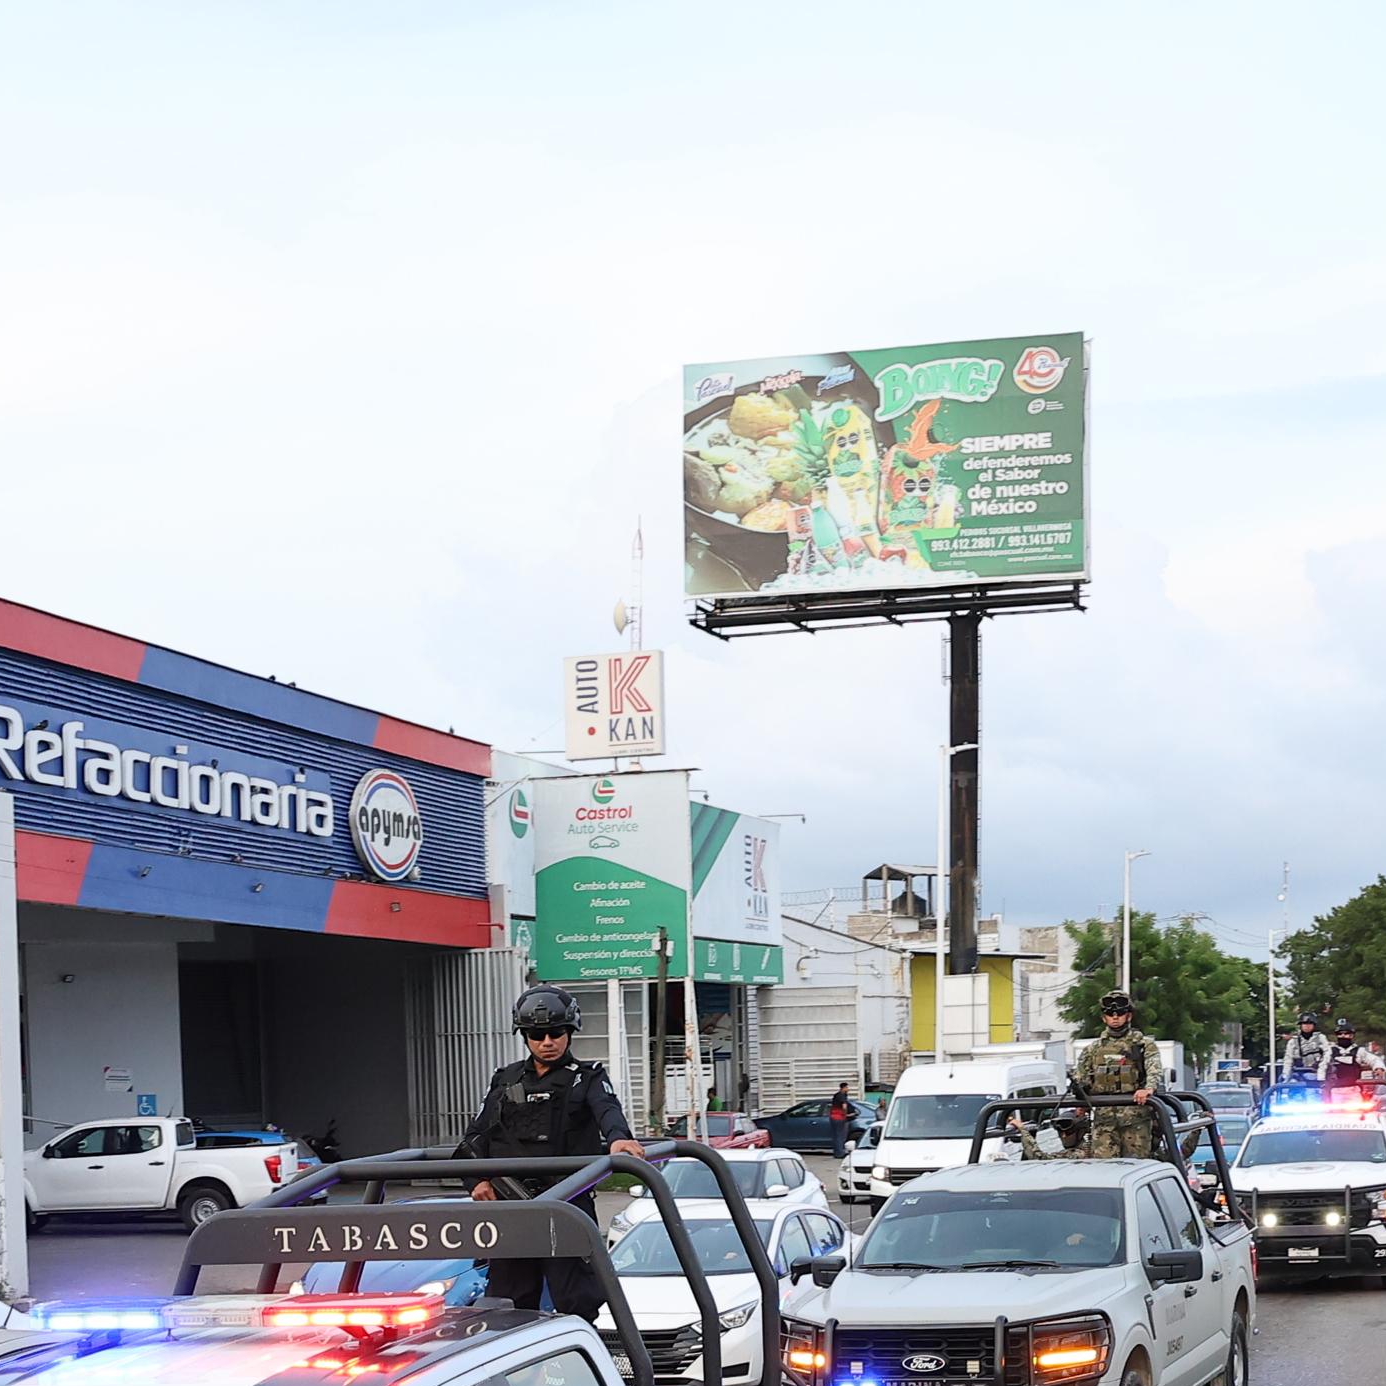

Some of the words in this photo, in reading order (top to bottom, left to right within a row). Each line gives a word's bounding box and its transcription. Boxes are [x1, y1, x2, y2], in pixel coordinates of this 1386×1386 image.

[876, 361, 1004, 418] BOING!
[960, 432, 1053, 453] SIEMPRE
[963, 453, 1072, 470] defenderemos
[978, 470, 992, 482] el
[995, 467, 1041, 481] Sabor
[967, 484, 992, 499] de
[996, 480, 1069, 498] nuestro
[971, 500, 1038, 516] México
[575, 660, 599, 714] AUTO
[609, 716, 654, 742] KAN
[575, 806, 632, 821] Castrol
[359, 806, 421, 847] apymsa
[568, 822, 595, 835] Auto
[598, 821, 639, 834] Service
[573, 882, 606, 891] Cambio
[608, 881, 619, 890] de
[620, 880, 647, 889] aceite
[596, 915, 624, 925] Frenos
[556, 933, 589, 944] Cambio
[590, 932, 602, 942] de
[602, 931, 661, 943] anticongelant
[563, 950, 612, 961] Suspensión
[613, 952, 619, 961] y
[580, 967, 618, 977] Sensores
[274, 1221, 498, 1252] TABASCO
[910, 1357, 938, 1369] Ford
